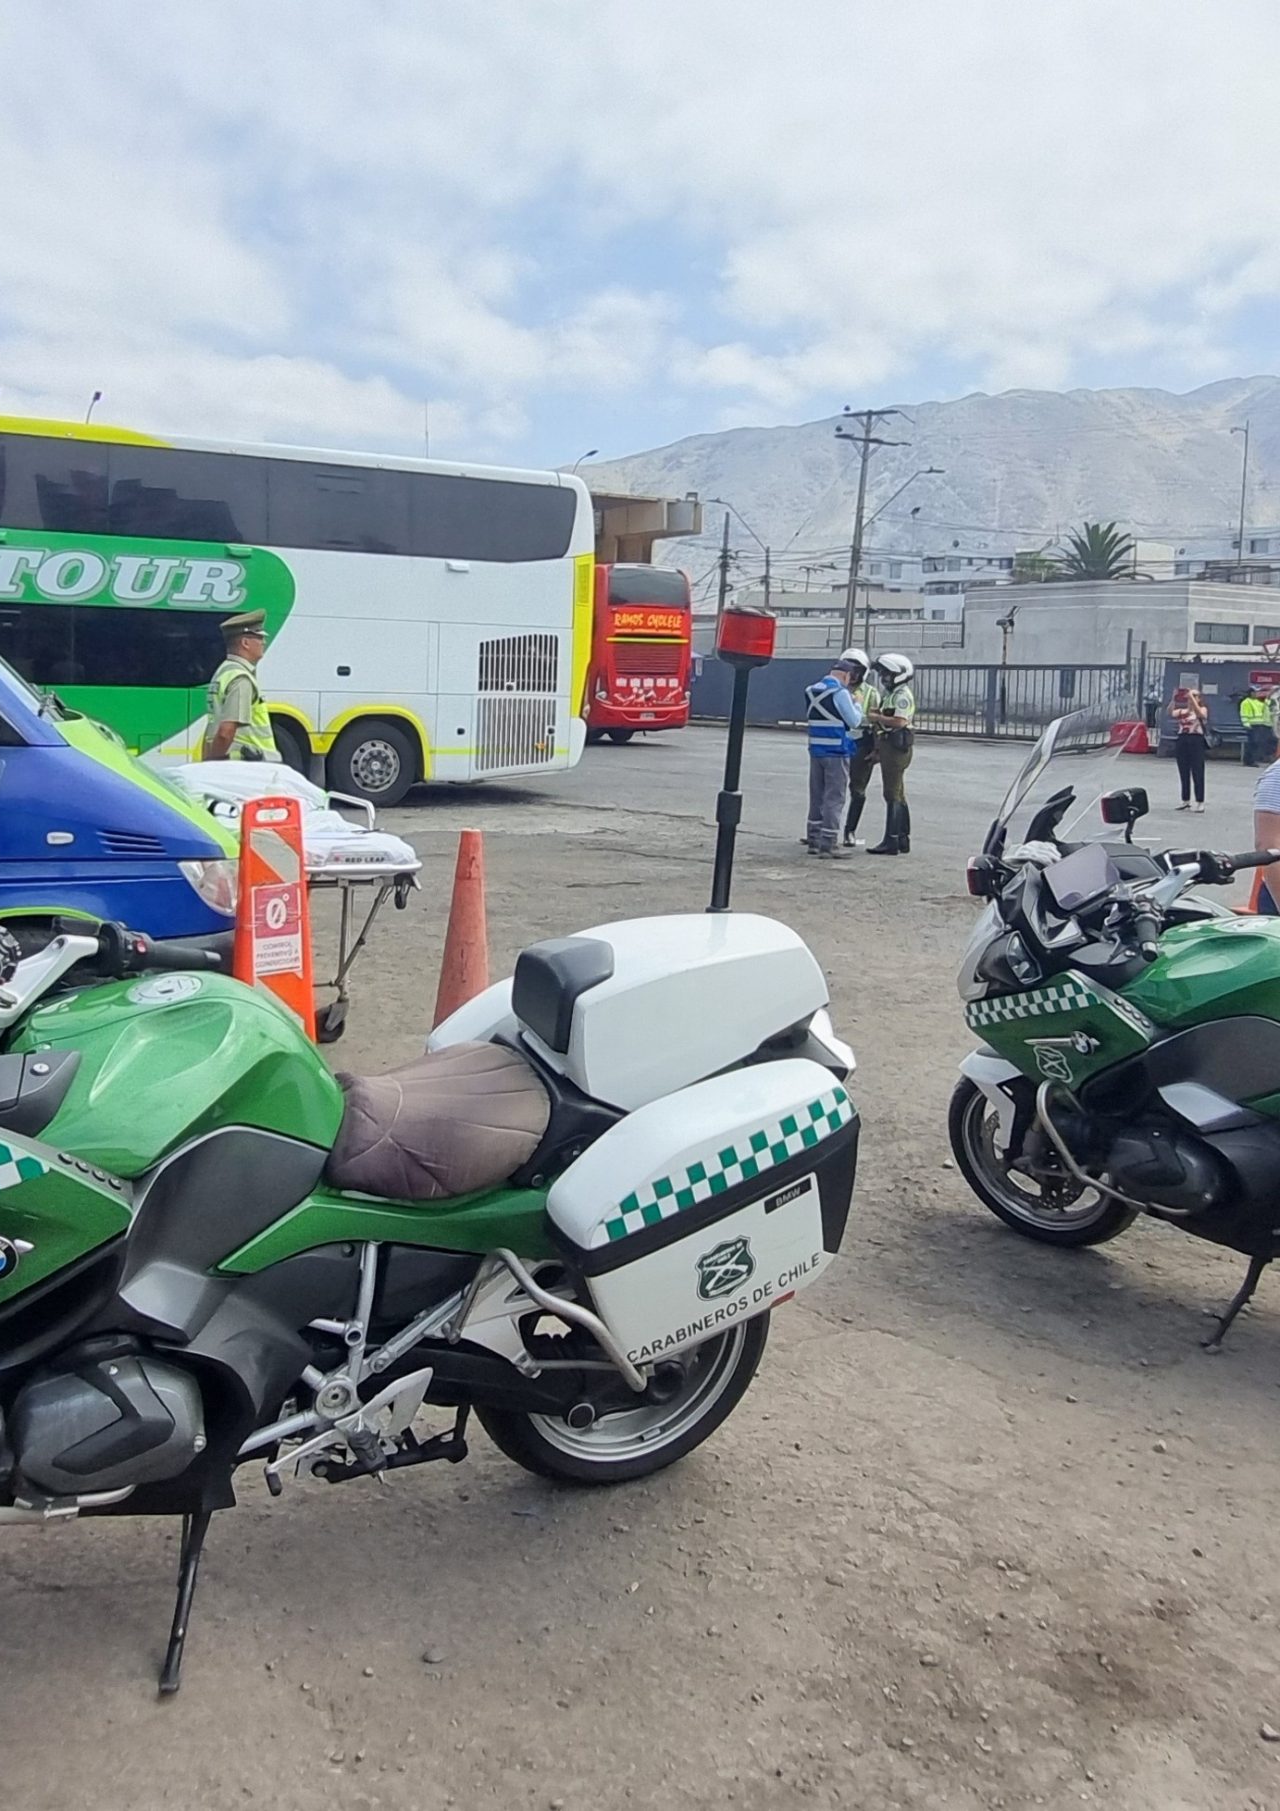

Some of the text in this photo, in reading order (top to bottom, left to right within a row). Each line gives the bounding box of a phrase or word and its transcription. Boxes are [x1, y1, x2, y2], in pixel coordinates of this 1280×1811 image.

[345, 855, 386, 864] RED LEAF
[775, 1186, 801, 1207] BMW
[626, 1296, 748, 1363] CARABINEROS
[752, 1281, 774, 1303] DE
[778, 1252, 821, 1288] CHILE
